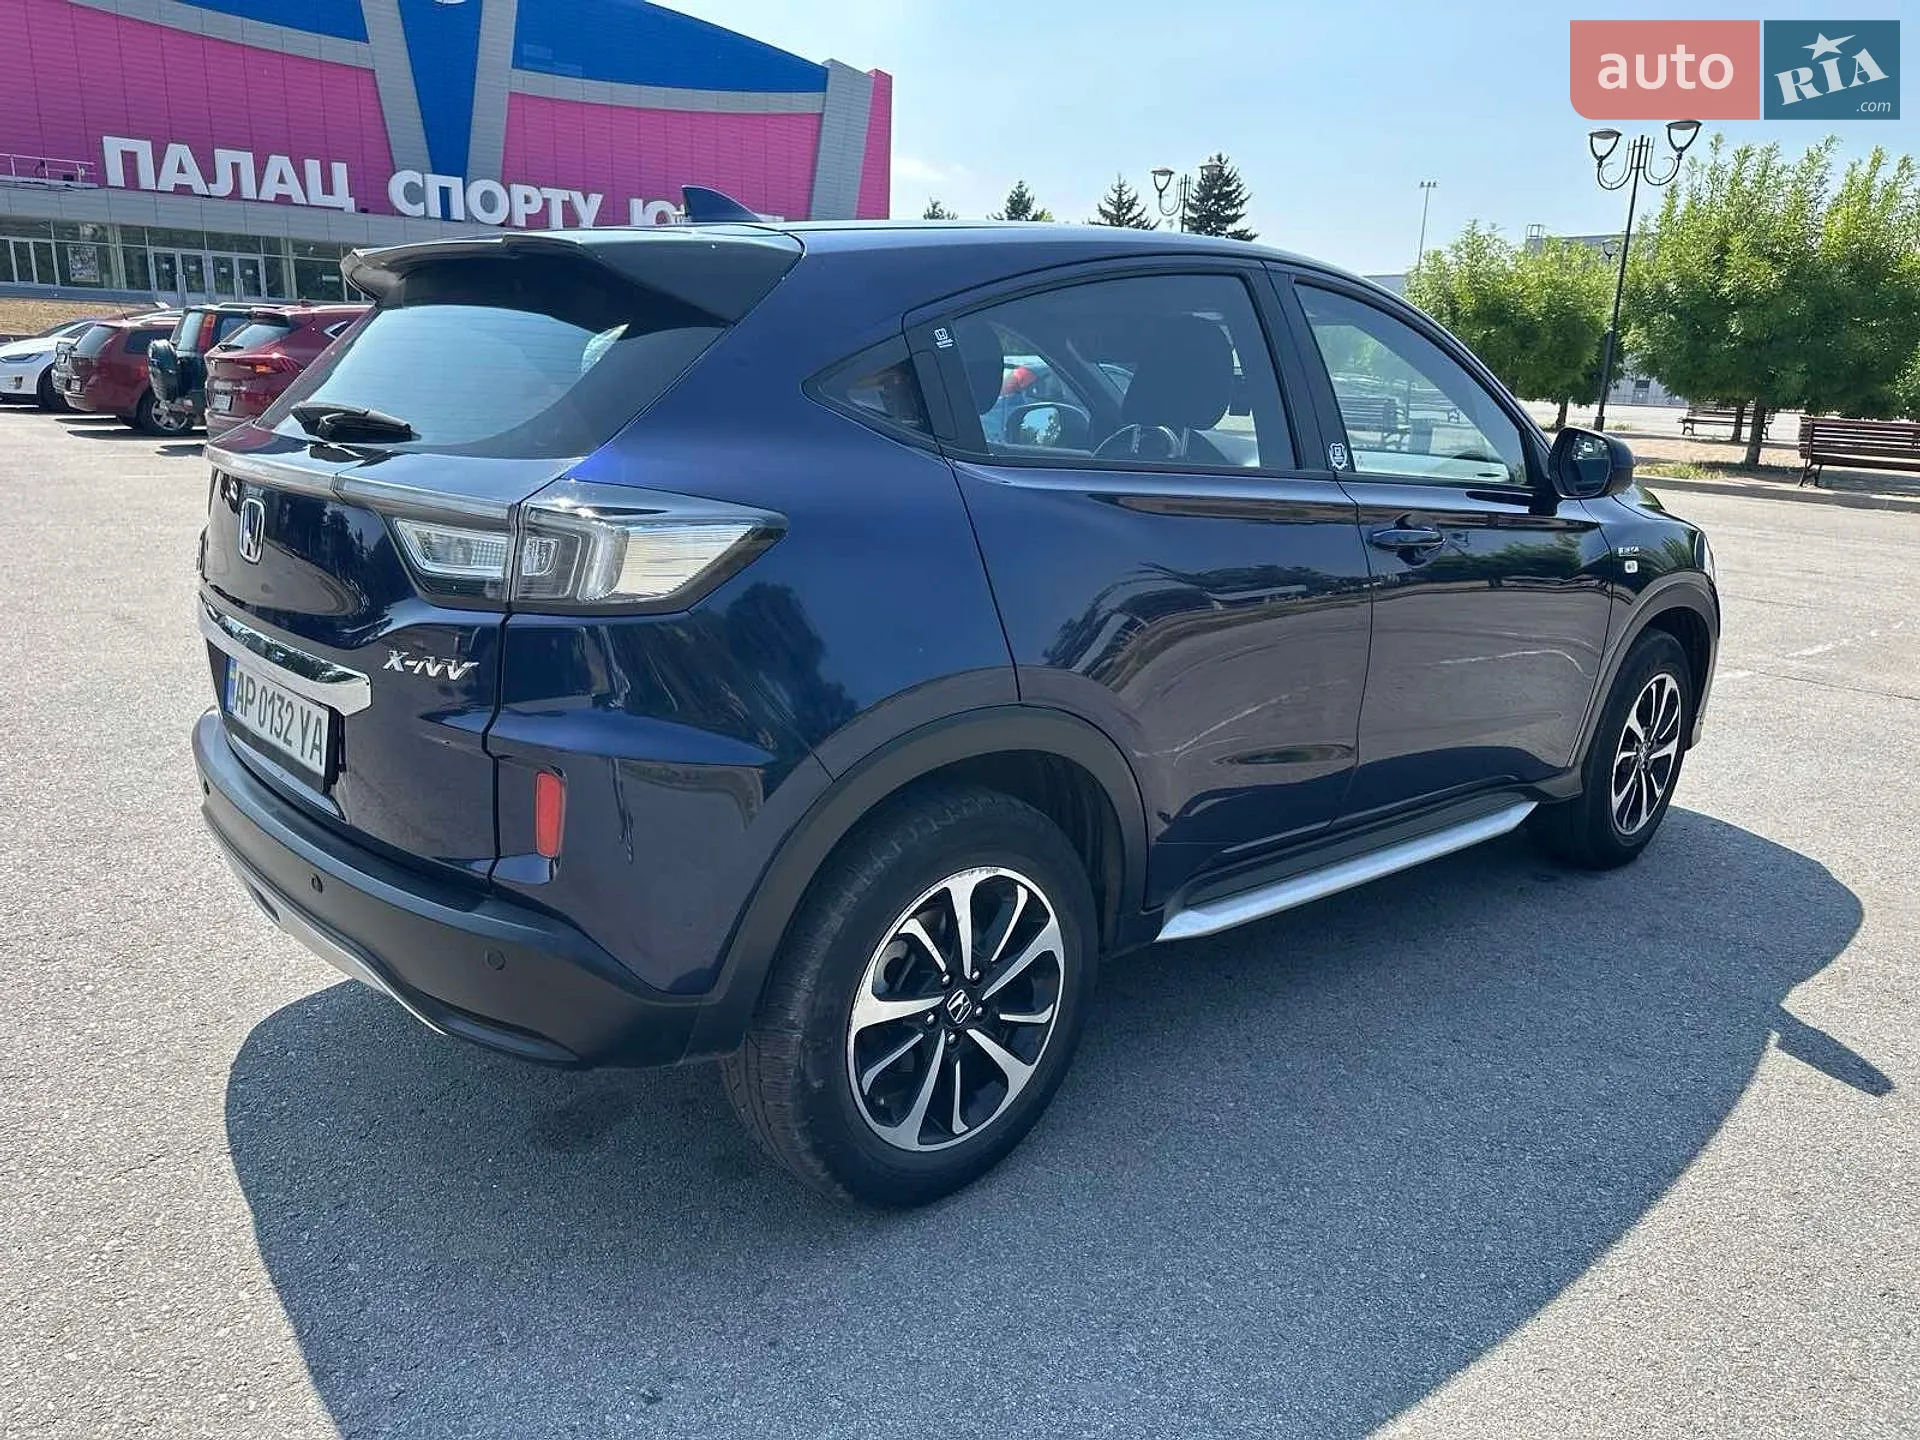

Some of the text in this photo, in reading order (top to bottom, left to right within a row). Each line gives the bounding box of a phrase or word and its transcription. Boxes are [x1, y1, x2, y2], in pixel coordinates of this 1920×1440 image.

[102, 135, 355, 213] ПАЛАЦ
[387, 169, 604, 230] СПОРТУ
[235, 671, 323, 767] AP 0132 YA
